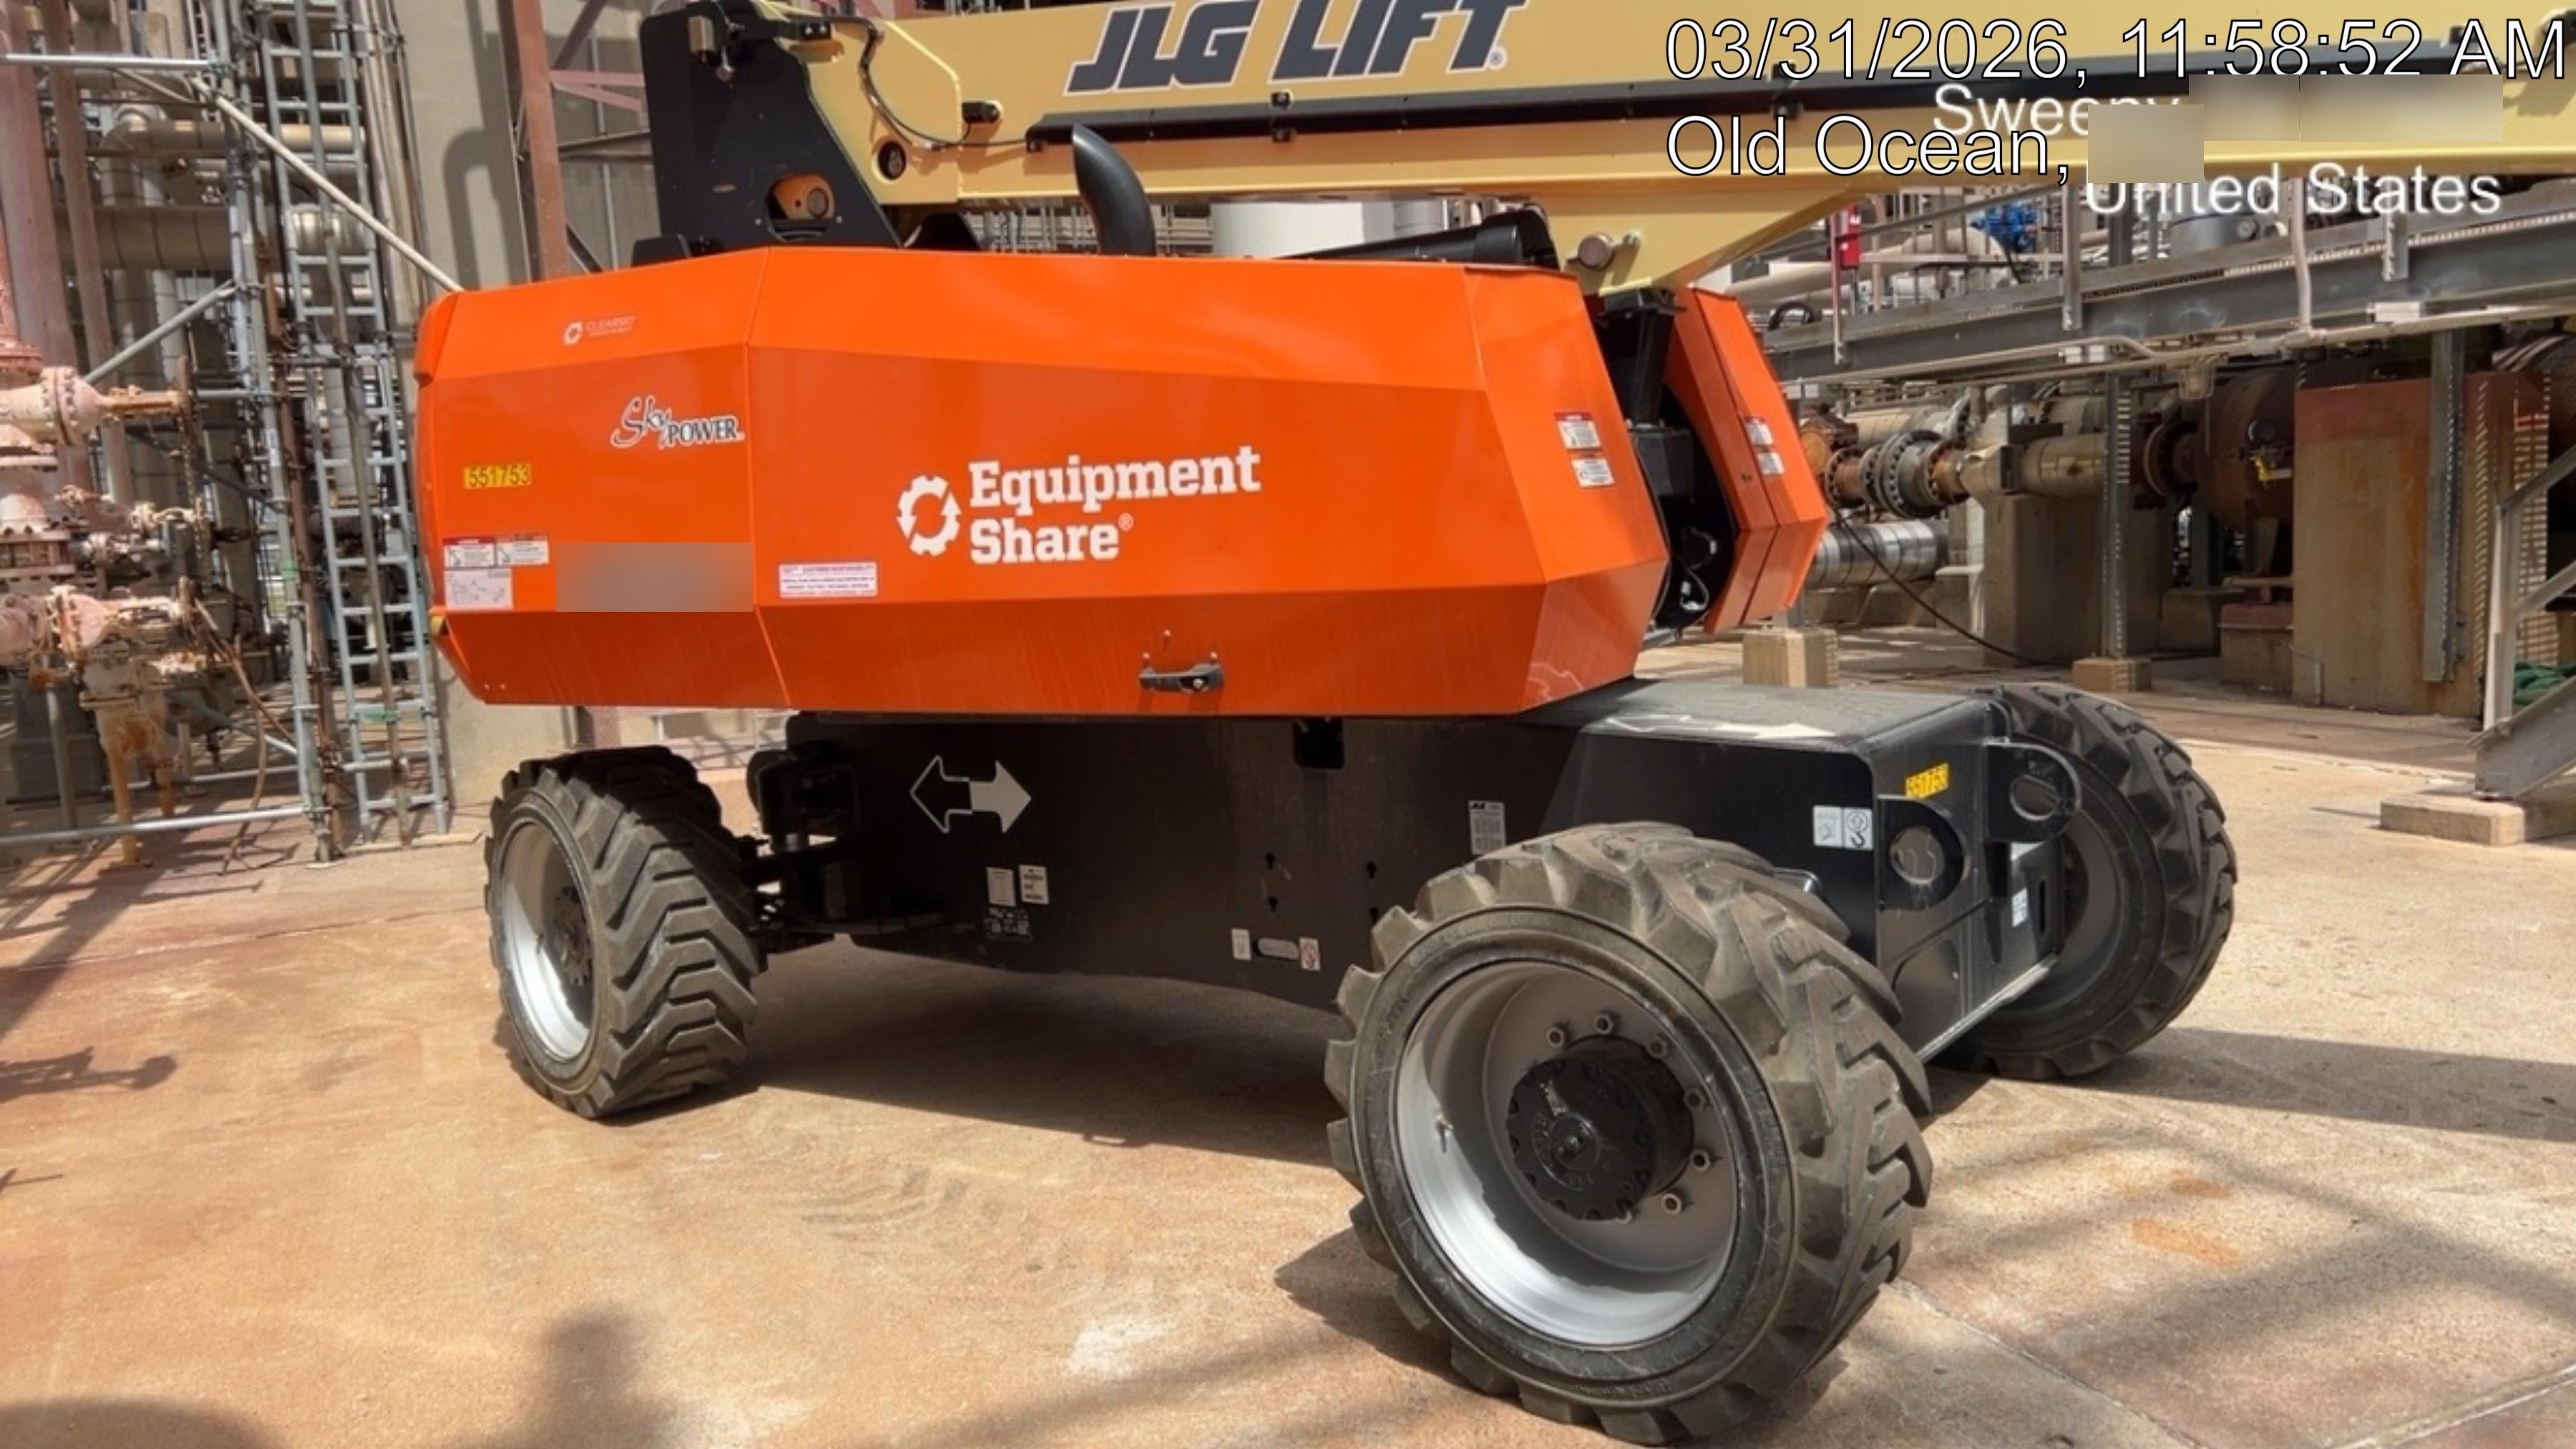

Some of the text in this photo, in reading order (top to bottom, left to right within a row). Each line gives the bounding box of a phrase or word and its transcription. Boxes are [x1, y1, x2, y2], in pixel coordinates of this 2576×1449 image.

[1064, 0, 1262, 94] JLG
[663, 415, 740, 447] POWER
[468, 464, 530, 488] 551753
[969, 445, 1262, 516] Equipment
